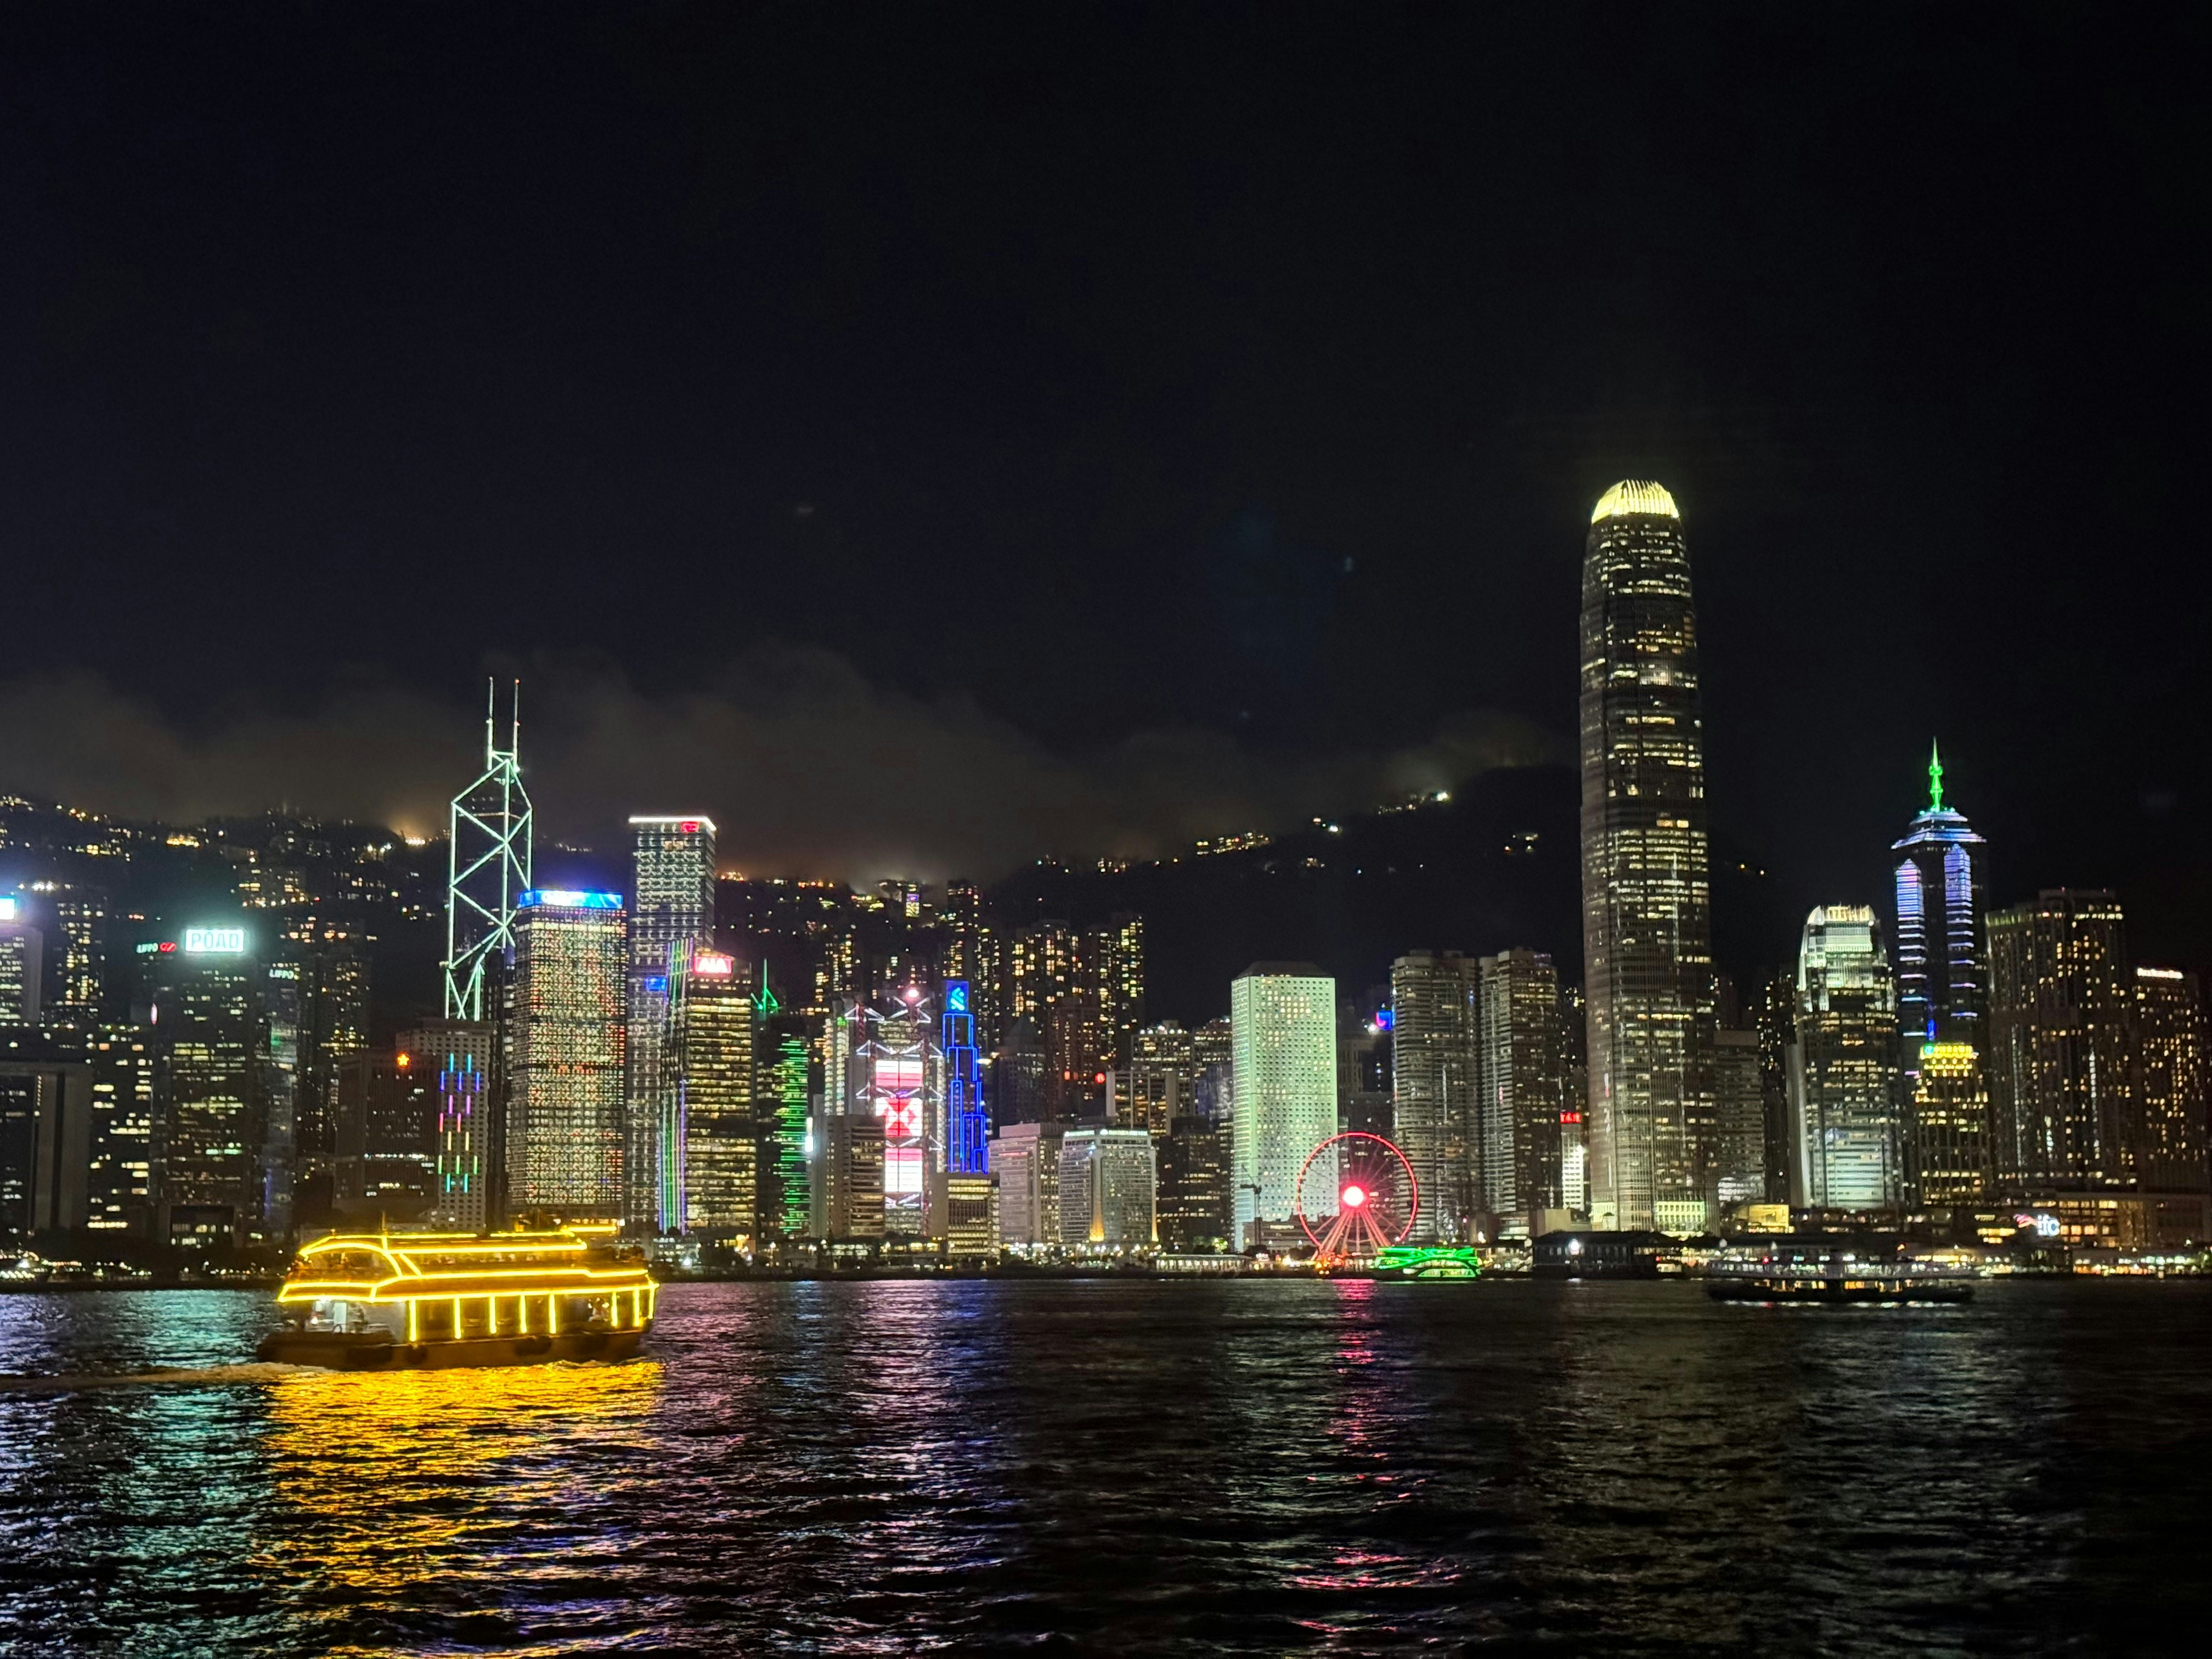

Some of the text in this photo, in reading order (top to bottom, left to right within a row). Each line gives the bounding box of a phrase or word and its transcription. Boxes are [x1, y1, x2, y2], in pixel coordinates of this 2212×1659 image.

[191, 932, 239, 949] POAD
[698, 957, 728, 973] AIA
[2038, 1215, 2061, 1236] ifc
